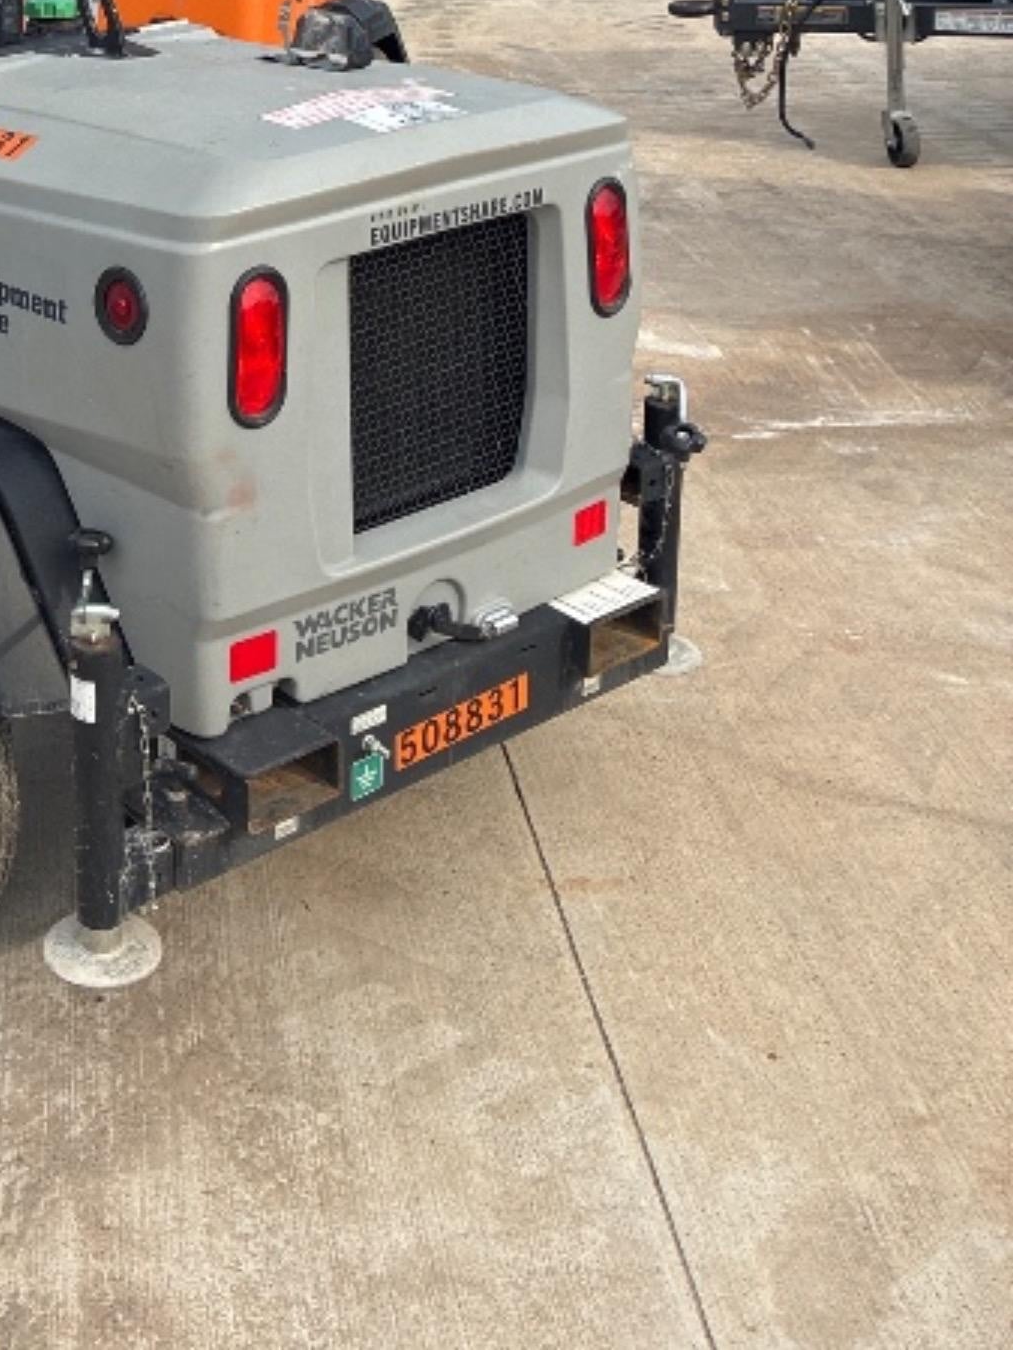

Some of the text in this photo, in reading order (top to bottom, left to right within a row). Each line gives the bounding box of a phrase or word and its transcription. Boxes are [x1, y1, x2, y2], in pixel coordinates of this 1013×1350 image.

[370, 187, 543, 247] EQUIPMENTSHARE.COM
[292, 587, 399, 638] WACKER
[295, 608, 399, 664] NEUSON
[400, 679, 520, 766] 508831
